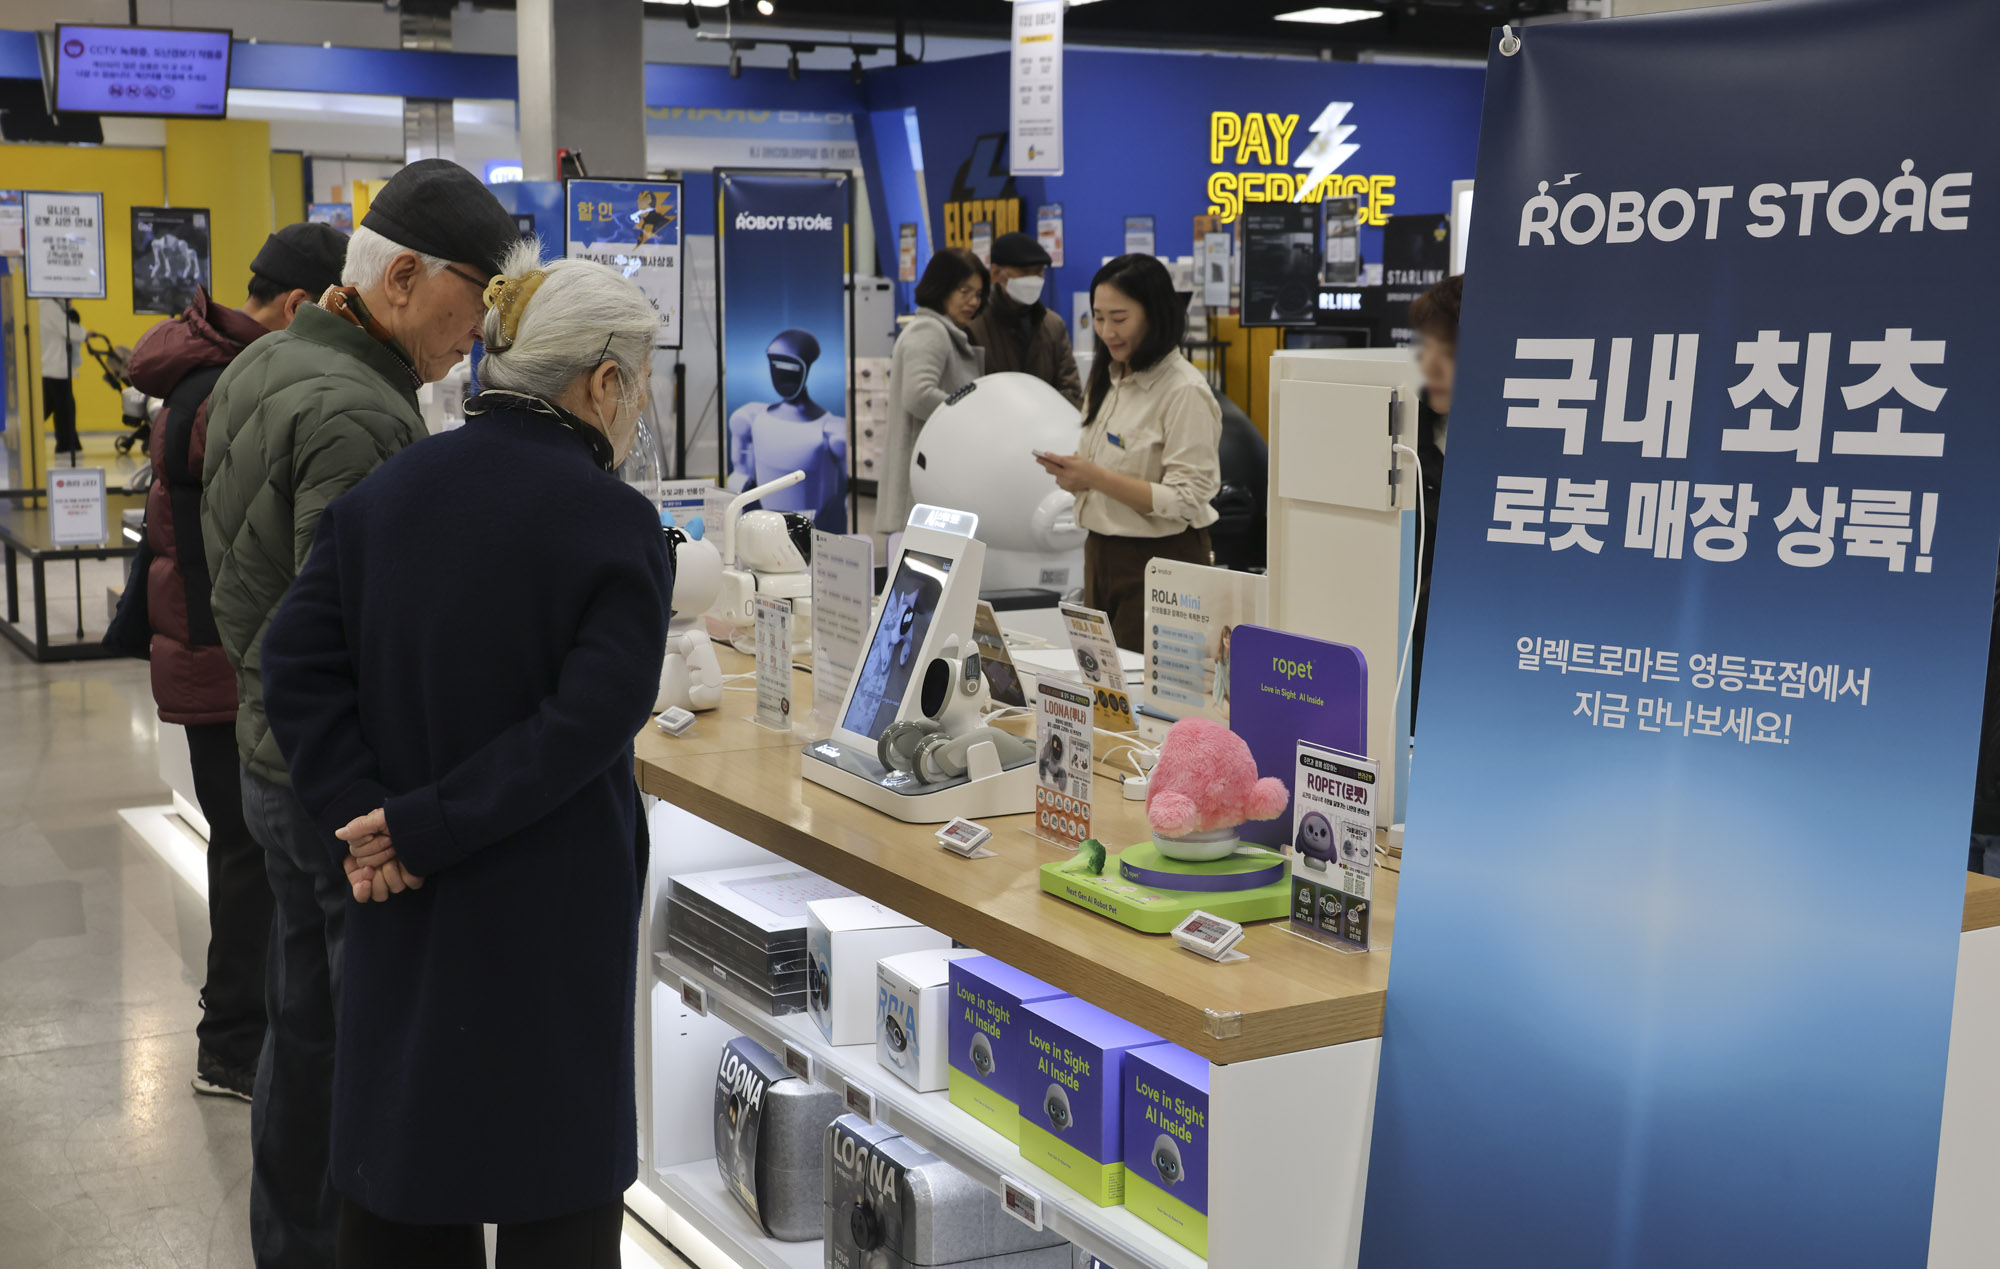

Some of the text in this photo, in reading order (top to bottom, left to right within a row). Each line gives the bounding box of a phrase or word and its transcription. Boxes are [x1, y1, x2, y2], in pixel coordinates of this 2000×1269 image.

[1210, 110, 1300, 166] PAY
[735, 212, 833, 231] ROBOT STORE
[1518, 158, 1973, 247] ROBOT STORE
[1503, 328, 1948, 463] 국내 최초
[1486, 475, 1939, 574] 로봇 매장 상륙!
[1152, 588, 1201, 610] ROLA Mini
[1272, 656, 1312, 680] ropet
[1516, 636, 1871, 706] 일렉트로마트 영등포점에서
[1260, 682, 1274, 694] Love
[1275, 686, 1280, 695] in
[1299, 692, 1306, 702] AI
[1306, 694, 1324, 706] Inside
[1572, 691, 1792, 745] 지금 만나보세요!
[1308, 772, 1368, 805] ROPET(로펫)
[1066, 886, 1078, 898] Next
[1078, 892, 1088, 900] Gen
[1094, 898, 1108, 911] Robot
[1108, 904, 1118, 914] Pet
[956, 982, 1010, 1025] Love in Sight
[964, 1008, 1001, 1039] AI Inside
[1029, 1029, 1090, 1077] Love in Sight
[1038, 1057, 1080, 1092] AI Inside
[720, 1048, 764, 1112] LOONA
[1136, 1076, 1205, 1128] Love in Sight
[1146, 1105, 1192, 1144] AI Inside
[833, 1127, 897, 1203] LOONA
